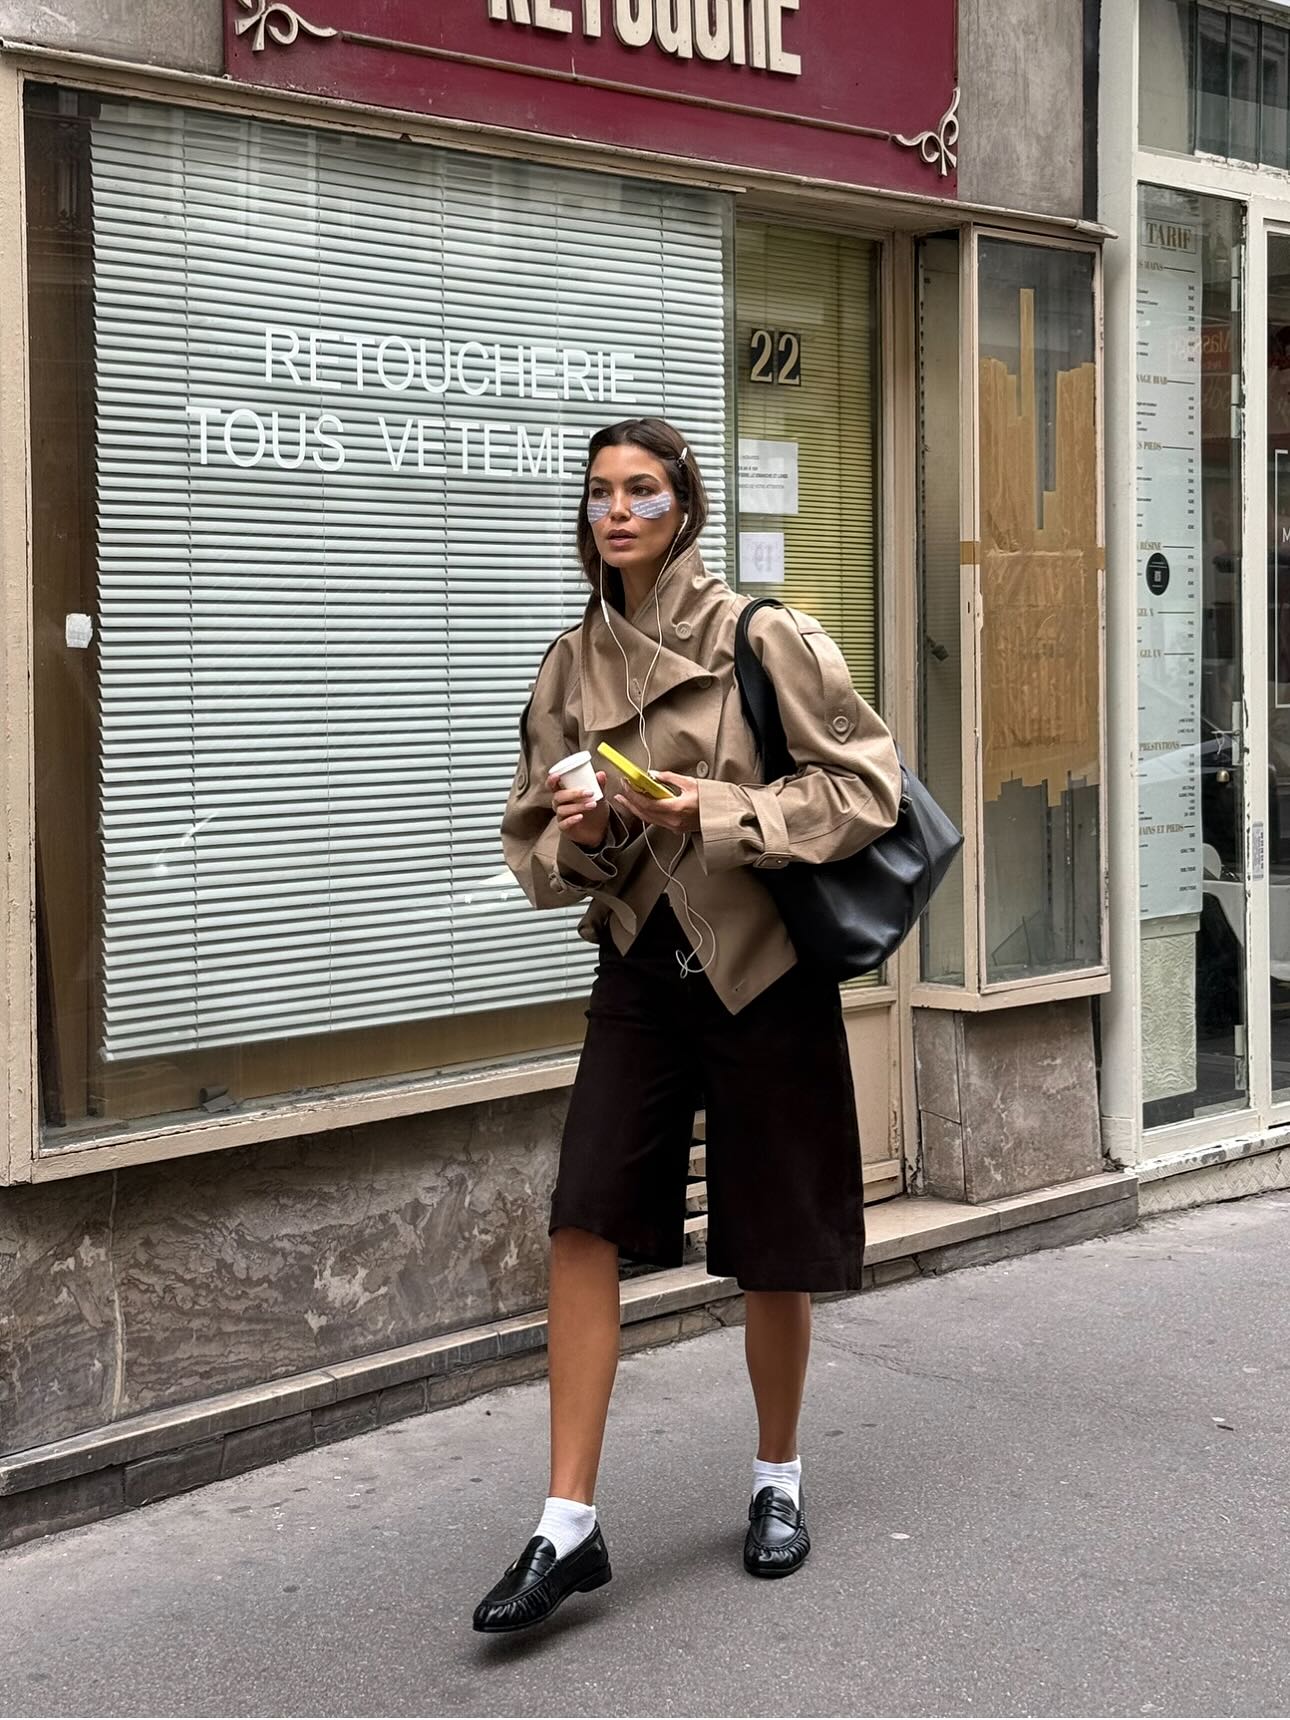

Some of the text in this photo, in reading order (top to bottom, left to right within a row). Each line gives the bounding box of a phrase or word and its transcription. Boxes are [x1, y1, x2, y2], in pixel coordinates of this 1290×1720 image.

[1146, 222, 1192, 250] TARIF
[264, 327, 638, 403] RETOUCHERIE
[750, 330, 800, 385] 22
[185, 405, 598, 479] TOUS VETEME
